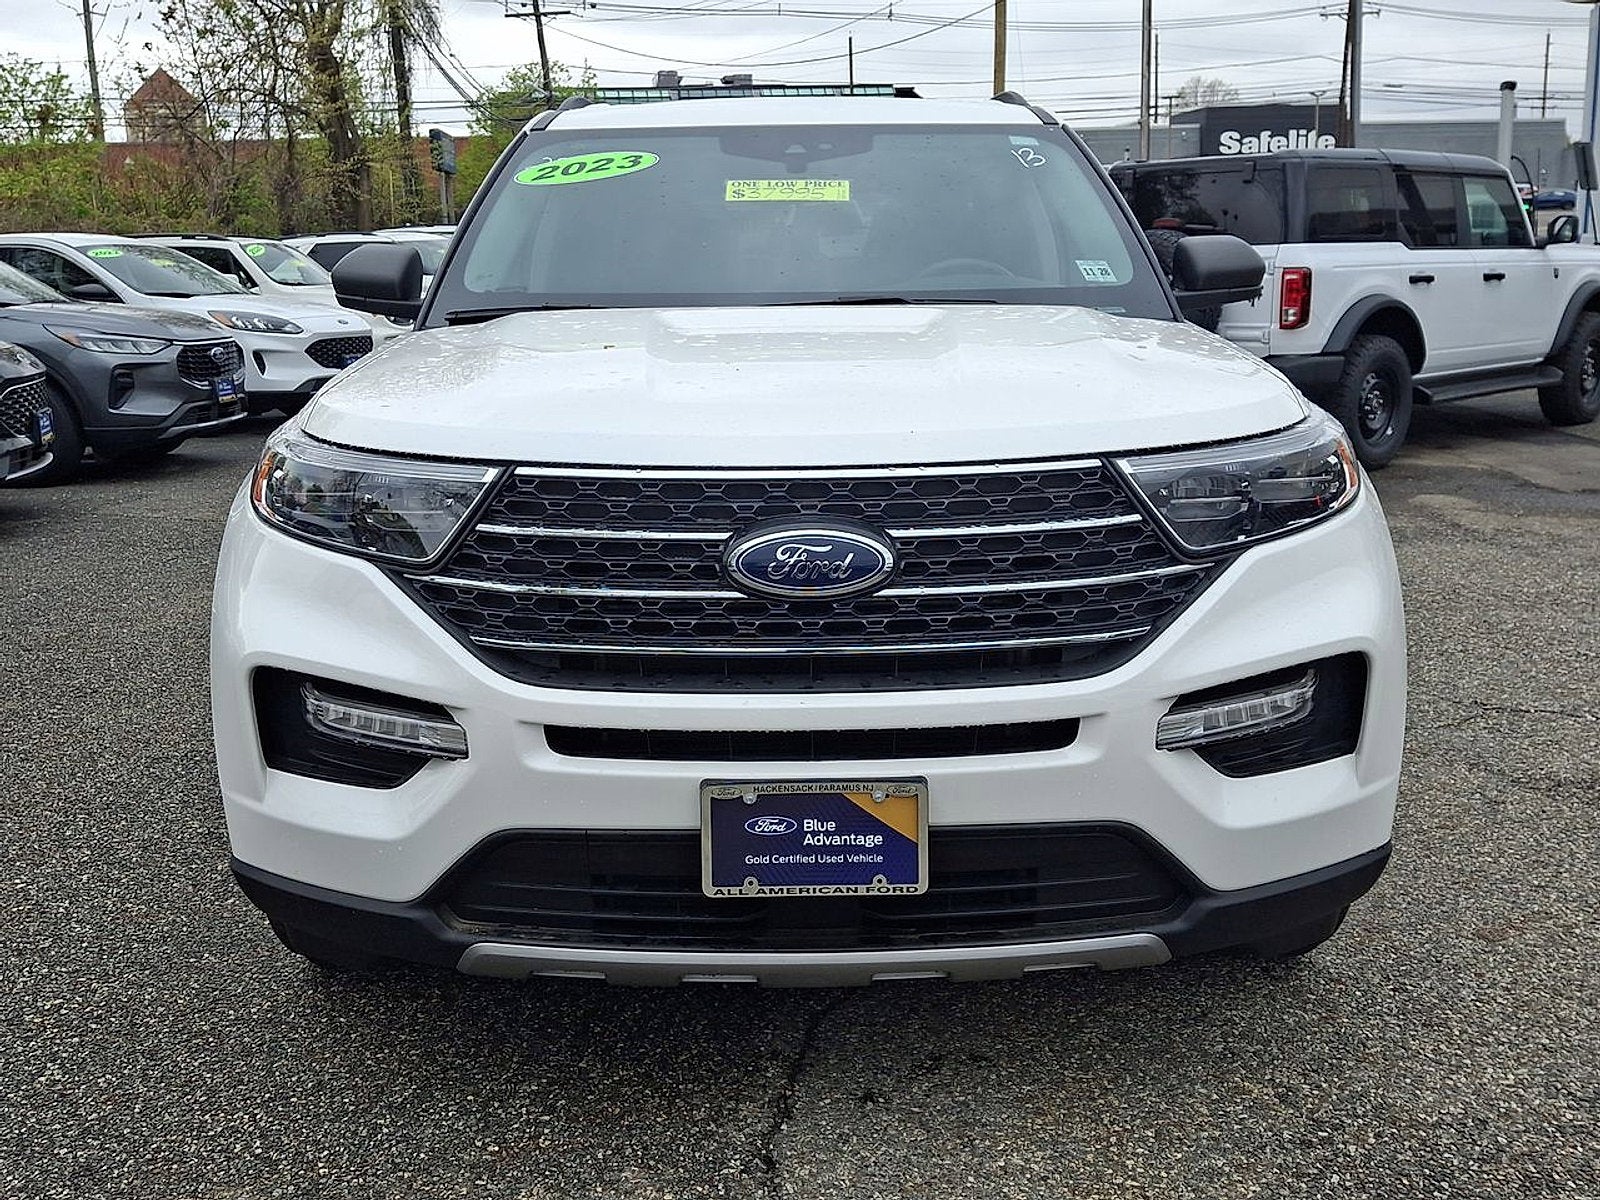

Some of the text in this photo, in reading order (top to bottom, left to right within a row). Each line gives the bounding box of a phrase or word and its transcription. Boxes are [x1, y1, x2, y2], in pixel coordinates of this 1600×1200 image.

[1219, 129, 1336, 154] Safelite
[531, 155, 643, 181] 2023
[731, 180, 845, 188] ONE LOW PRICE
[767, 543, 854, 580] Ford
[862, 784, 874, 793] NJ
[754, 818, 788, 833] Ford
[803, 818, 837, 832] Blue
[803, 833, 884, 848] Advantage
[744, 852, 884, 865] Gold Certified Used Vehicle
[713, 885, 919, 897] ALL AMERICAN FORD
